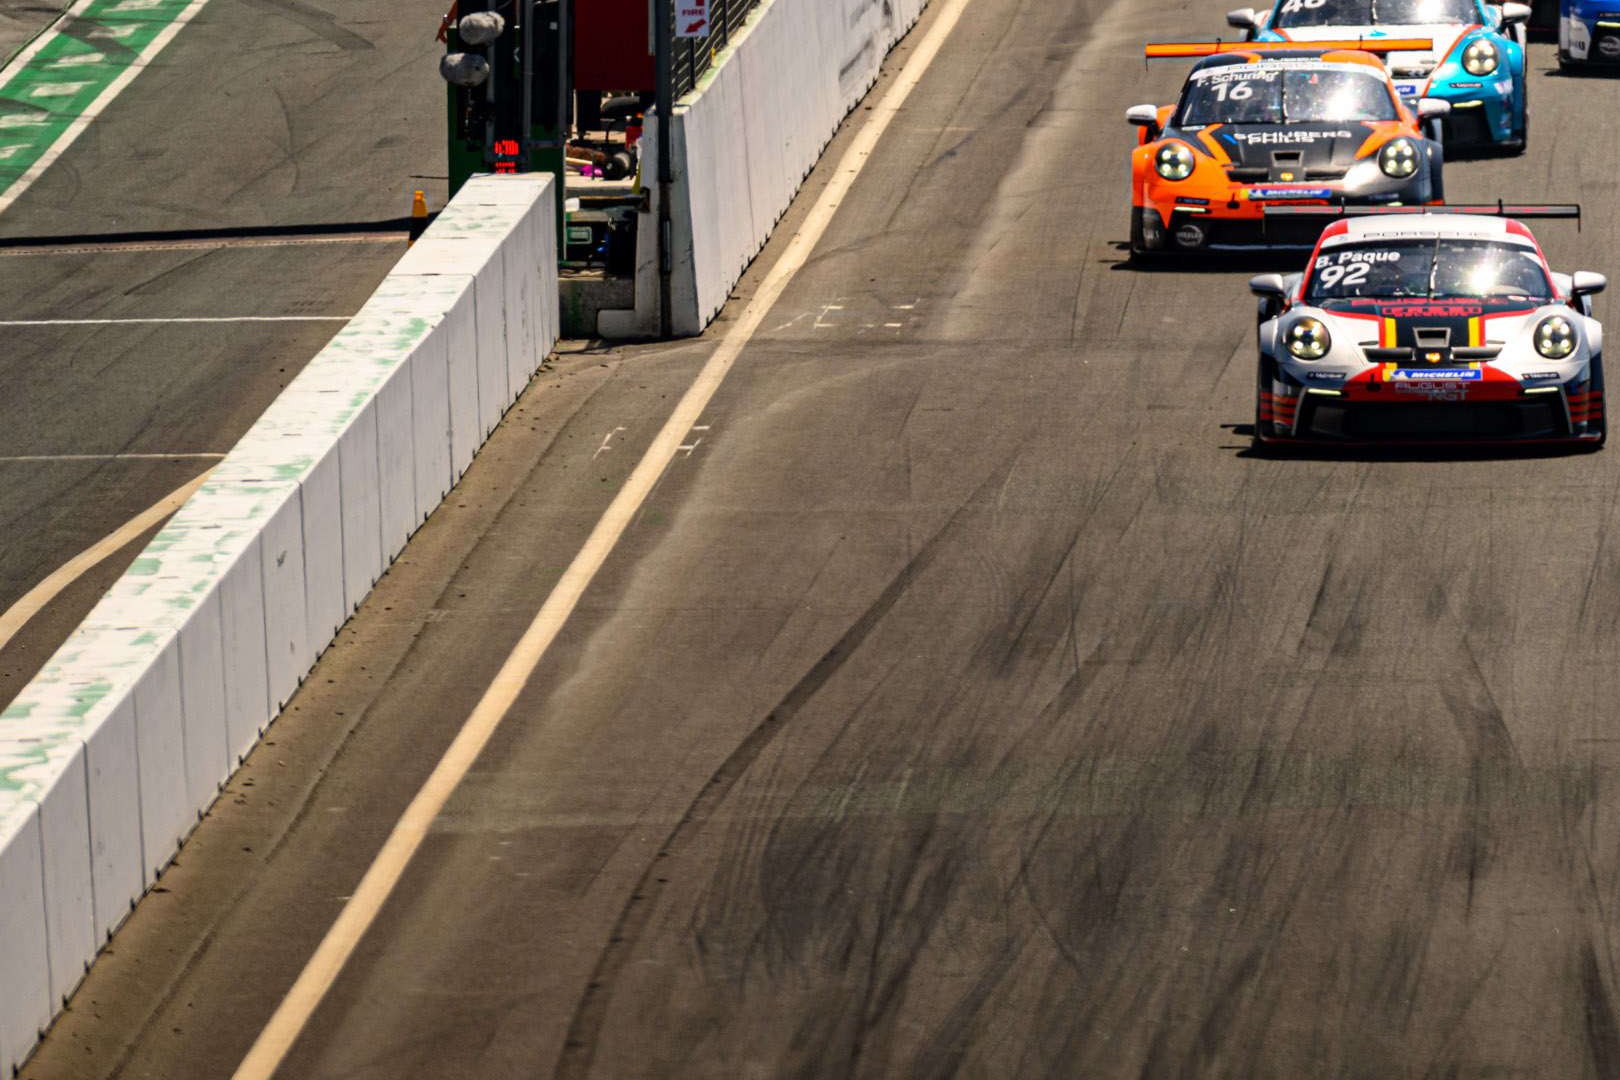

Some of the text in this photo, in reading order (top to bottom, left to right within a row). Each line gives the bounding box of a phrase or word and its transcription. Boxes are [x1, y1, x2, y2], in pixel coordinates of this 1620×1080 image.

[682, 8, 705, 17] FIRE
[1211, 69, 1277, 84] Schuring
[1210, 81, 1253, 102] 16
[1315, 249, 1401, 270] B. Paque
[1319, 261, 1371, 290] 92
[1411, 369, 1476, 380] MICHELIN
